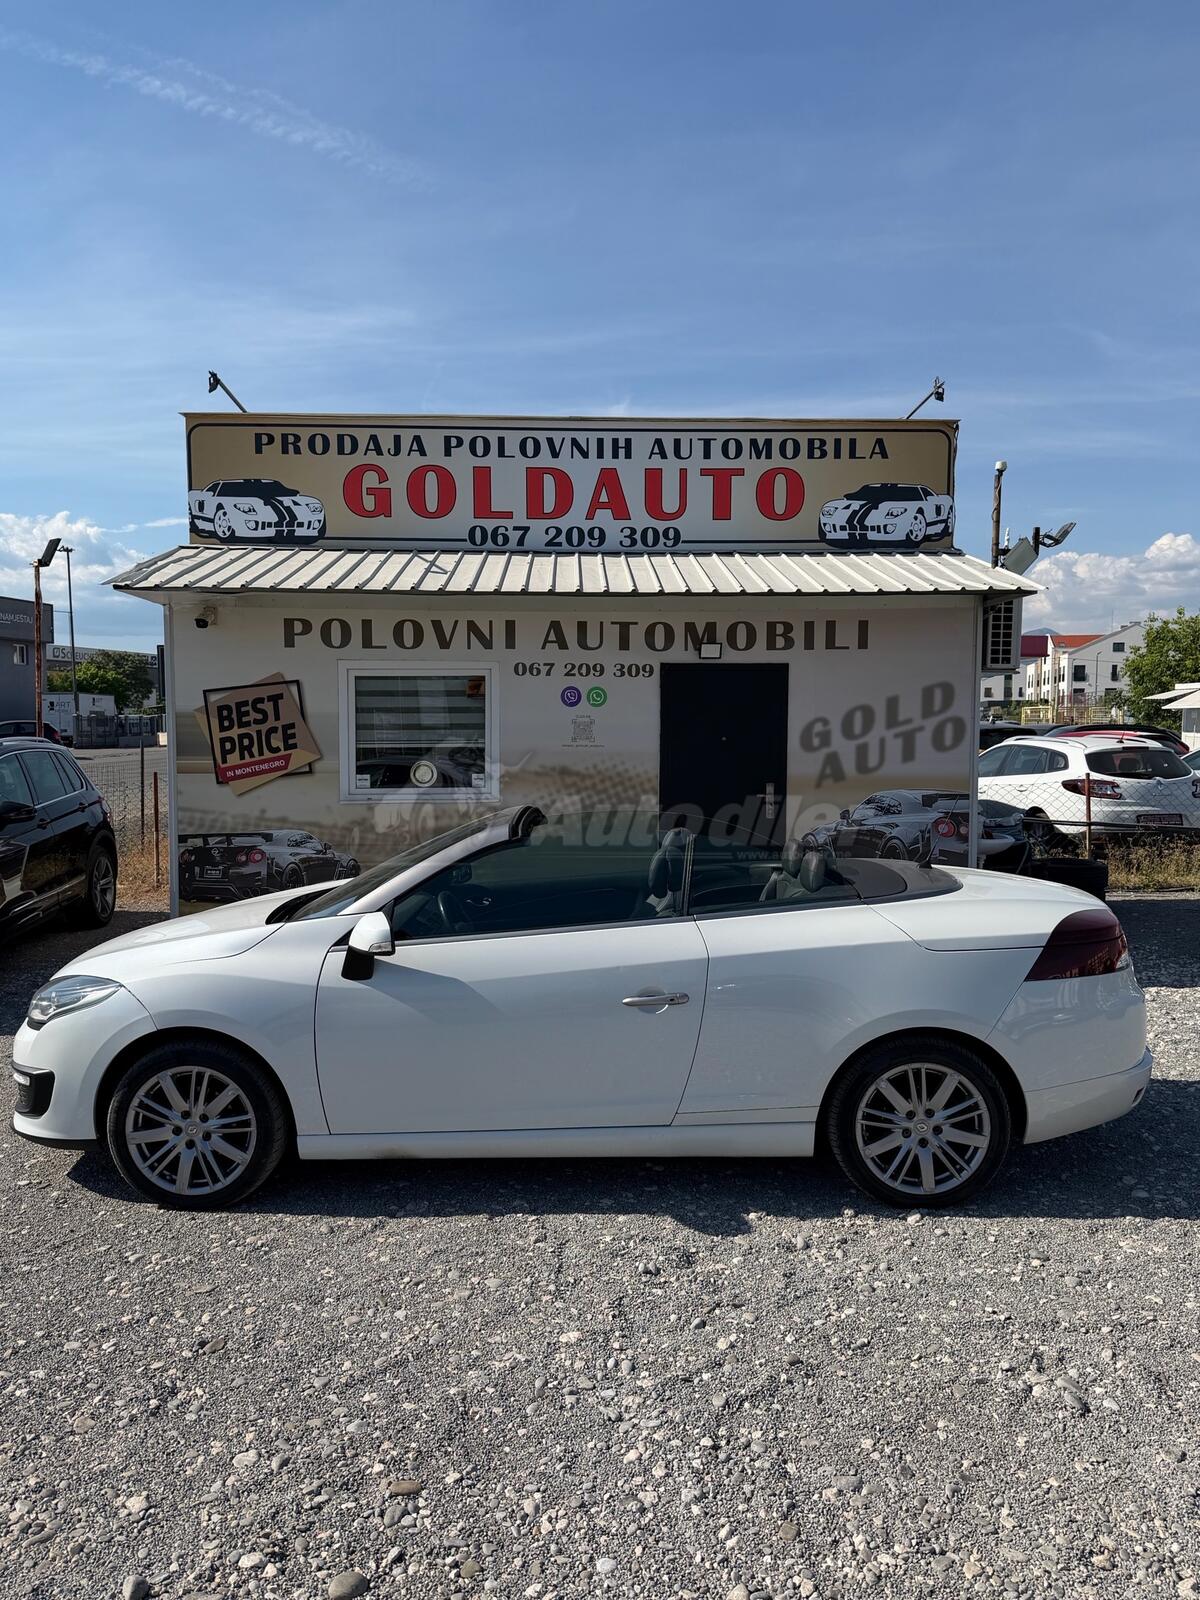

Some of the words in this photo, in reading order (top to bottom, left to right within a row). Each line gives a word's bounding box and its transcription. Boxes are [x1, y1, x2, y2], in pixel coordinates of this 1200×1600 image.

[254, 432, 428, 457] PRODAJA
[443, 435, 633, 460] POLOVNIH
[648, 437, 890, 460] AUTOMOBILA
[342, 463, 806, 522] GOLDAUTO
[467, 525, 530, 548] 067
[544, 525, 606, 548] 209
[619, 526, 682, 548] 309
[283, 617, 516, 651] POLOVNI
[541, 618, 869, 652] AUTOMOBILI
[513, 661, 555, 677] 067
[563, 662, 605, 677] 209
[613, 662, 655, 678] 309
[216, 692, 284, 733] BEST
[799, 680, 956, 753] GOLD
[219, 722, 298, 765] PRICE
[814, 715, 967, 789] AUTO
[226, 769, 234, 778] IN
[235, 759, 286, 776] MONTENEGRO
